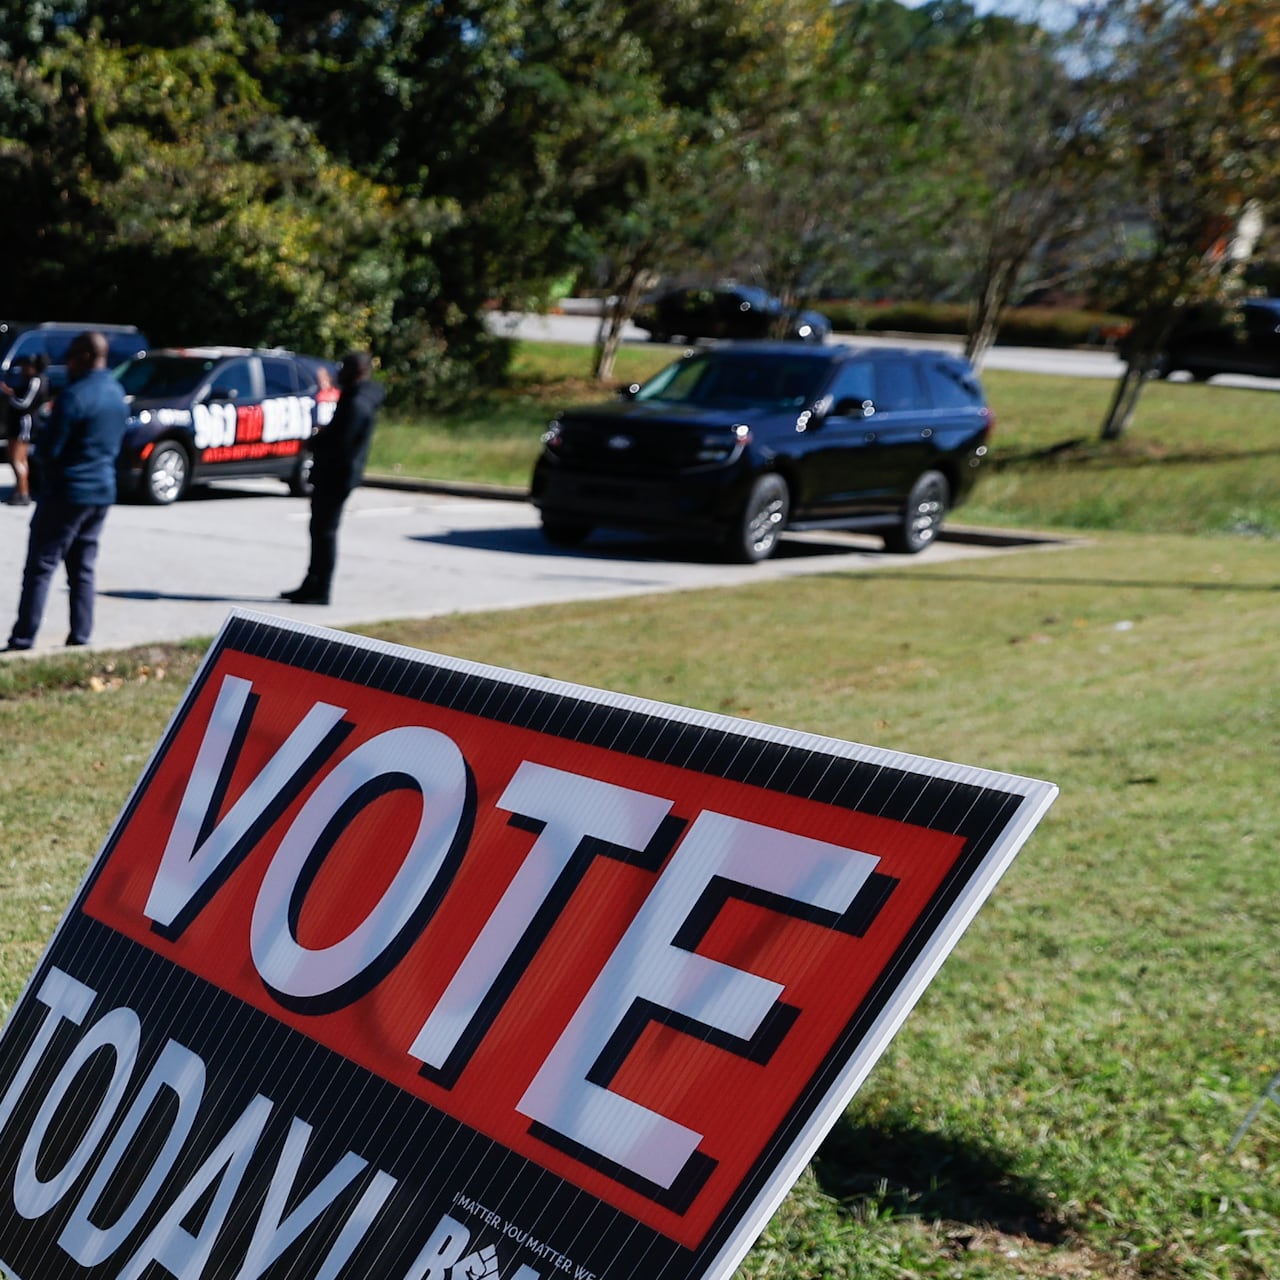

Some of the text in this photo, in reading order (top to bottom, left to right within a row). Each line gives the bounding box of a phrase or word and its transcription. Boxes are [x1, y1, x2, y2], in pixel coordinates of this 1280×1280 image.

[144, 674, 886, 1195] VOTE
[458, 1195, 500, 1229] MATTER.
[502, 1221, 528, 1243] YOU
[525, 1235, 571, 1274] MATTER.
